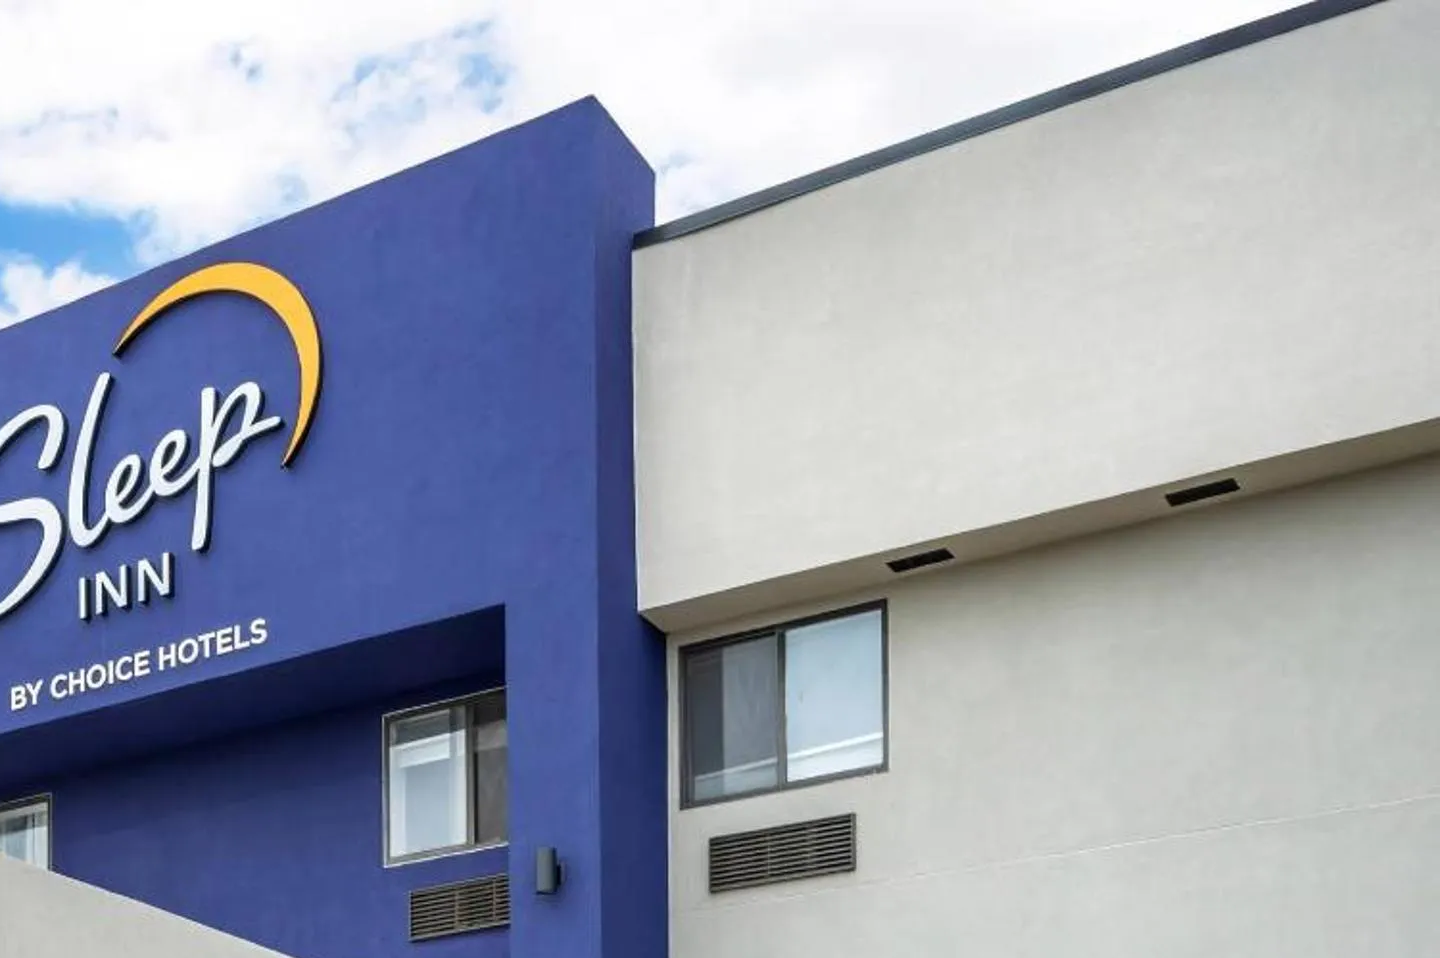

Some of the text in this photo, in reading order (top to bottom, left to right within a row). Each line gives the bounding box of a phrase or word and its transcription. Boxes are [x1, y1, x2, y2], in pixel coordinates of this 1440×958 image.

[79, 551, 172, 620] INN
[10, 618, 268, 711] BY CHOICE HOTELS
